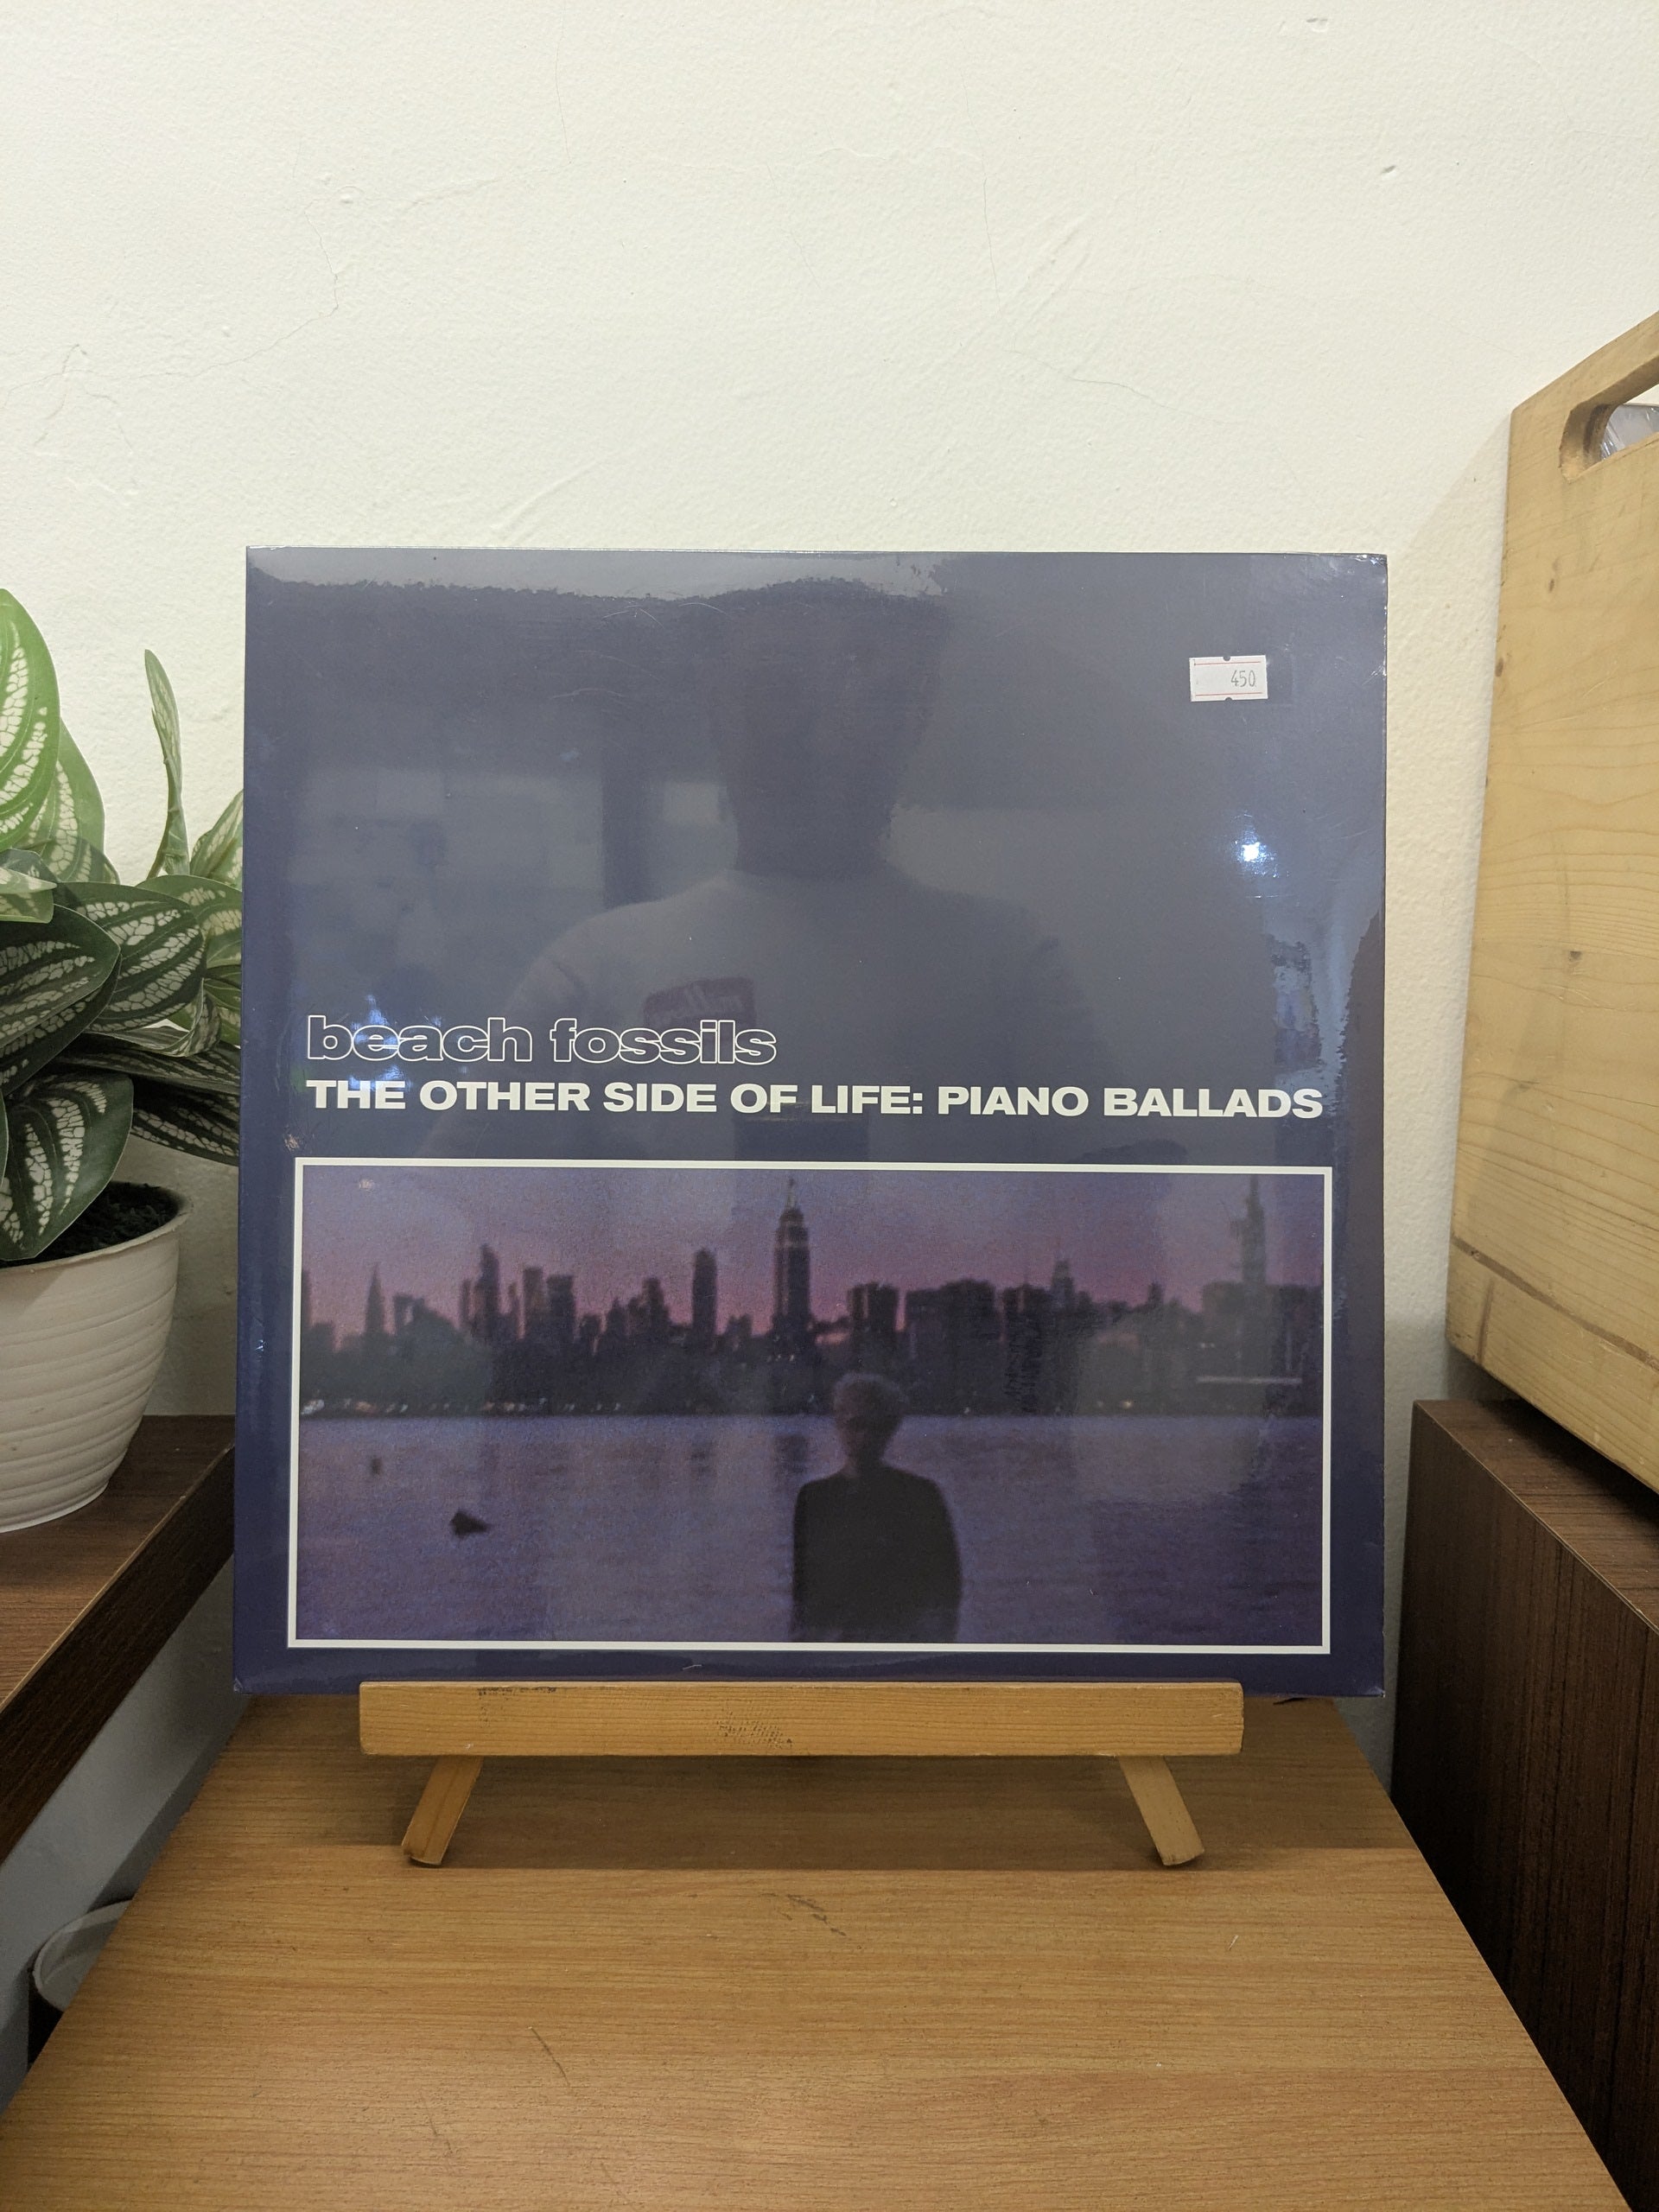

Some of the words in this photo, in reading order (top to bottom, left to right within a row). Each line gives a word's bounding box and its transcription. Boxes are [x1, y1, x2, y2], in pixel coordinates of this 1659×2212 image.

[1230, 670, 1256, 688] 450
[307, 1014, 533, 1062] beach
[550, 1018, 777, 1065] fossils
[306, 1079, 406, 1109] THE
[419, 1079, 591, 1111] OTHER
[603, 1081, 716, 1113] SIDE
[730, 1083, 798, 1114] OF
[811, 1084, 923, 1116] LIFE:
[938, 1085, 1089, 1117] PIANO
[1103, 1087, 1324, 1120] BALLADS
